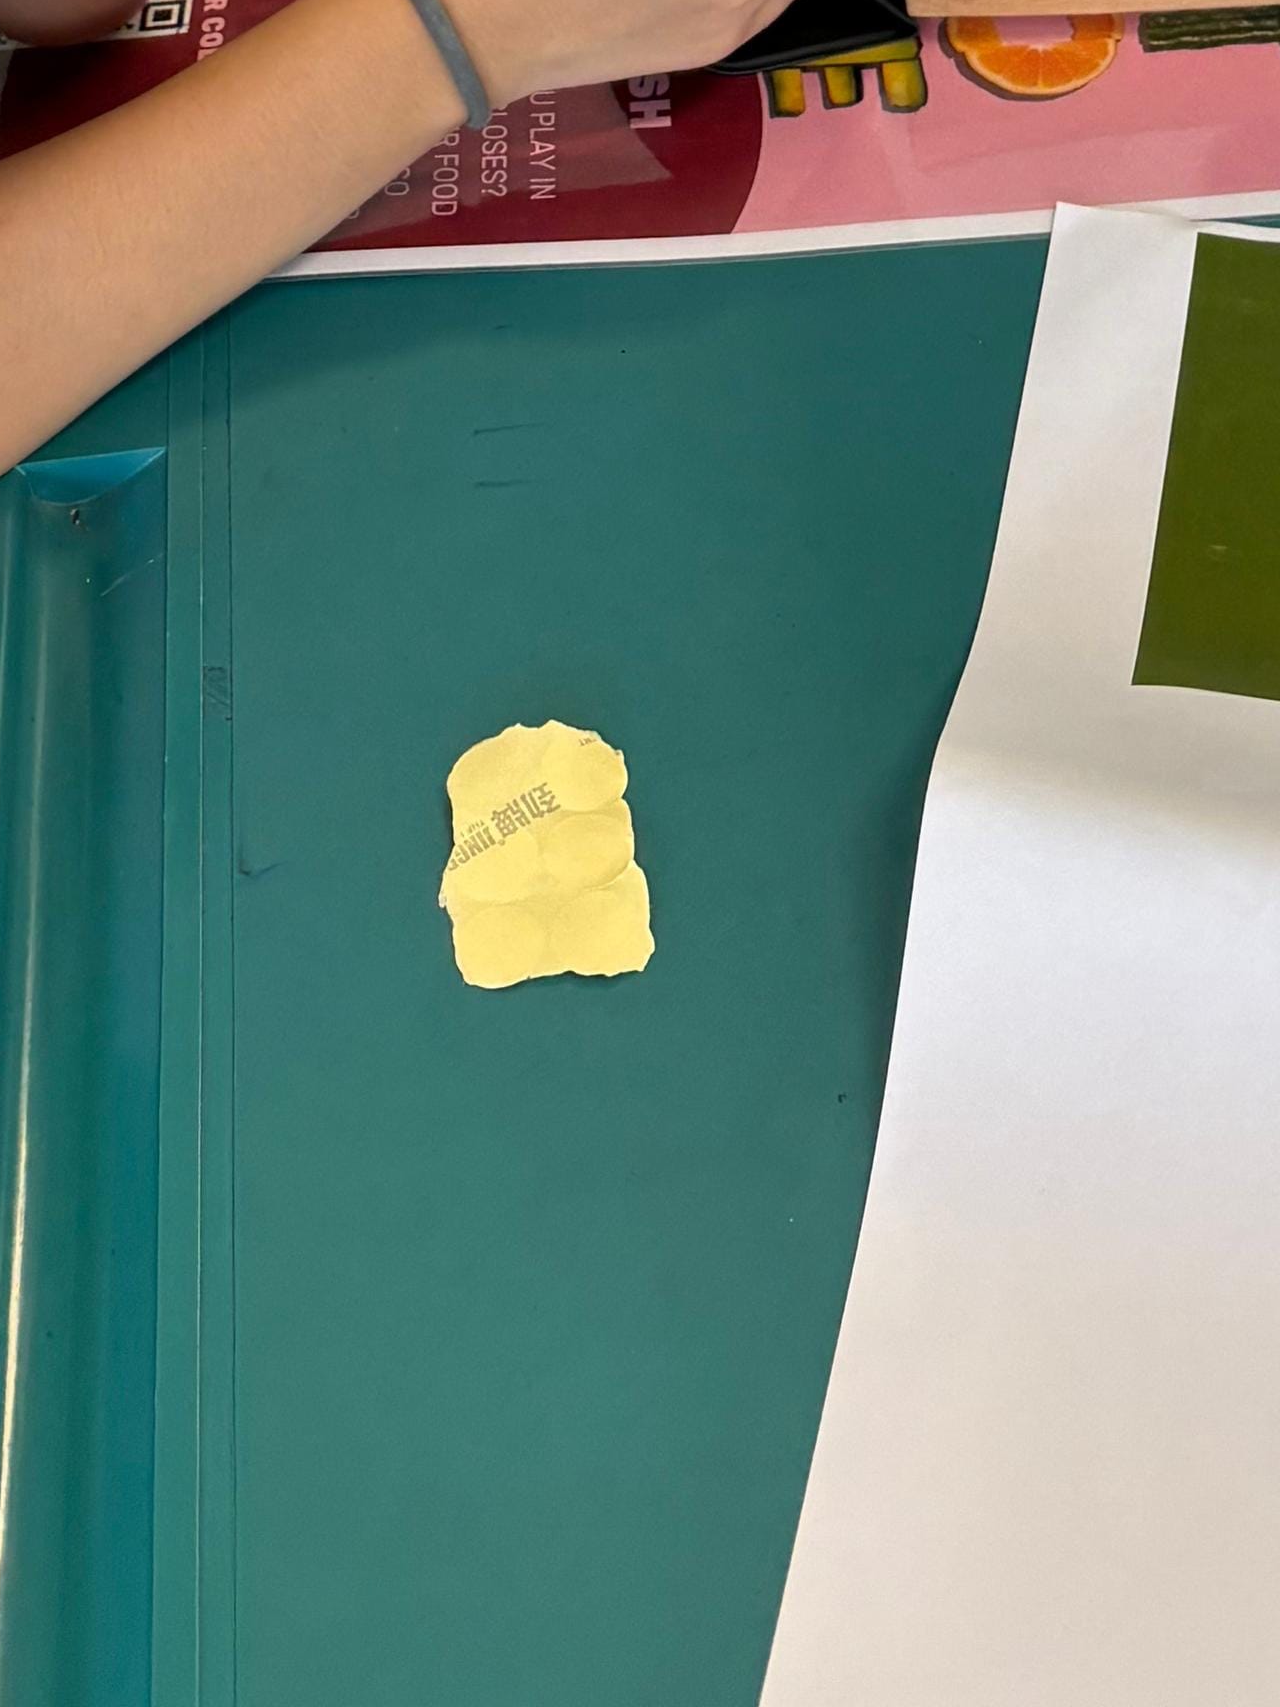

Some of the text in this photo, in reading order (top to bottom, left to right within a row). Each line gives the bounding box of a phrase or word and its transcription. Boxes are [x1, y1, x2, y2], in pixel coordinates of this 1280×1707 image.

[196, 14, 225, 64] CO
[529, 111, 557, 172] PLAY
[431, 153, 460, 217] FOOD
[529, 177, 557, 201] IN
